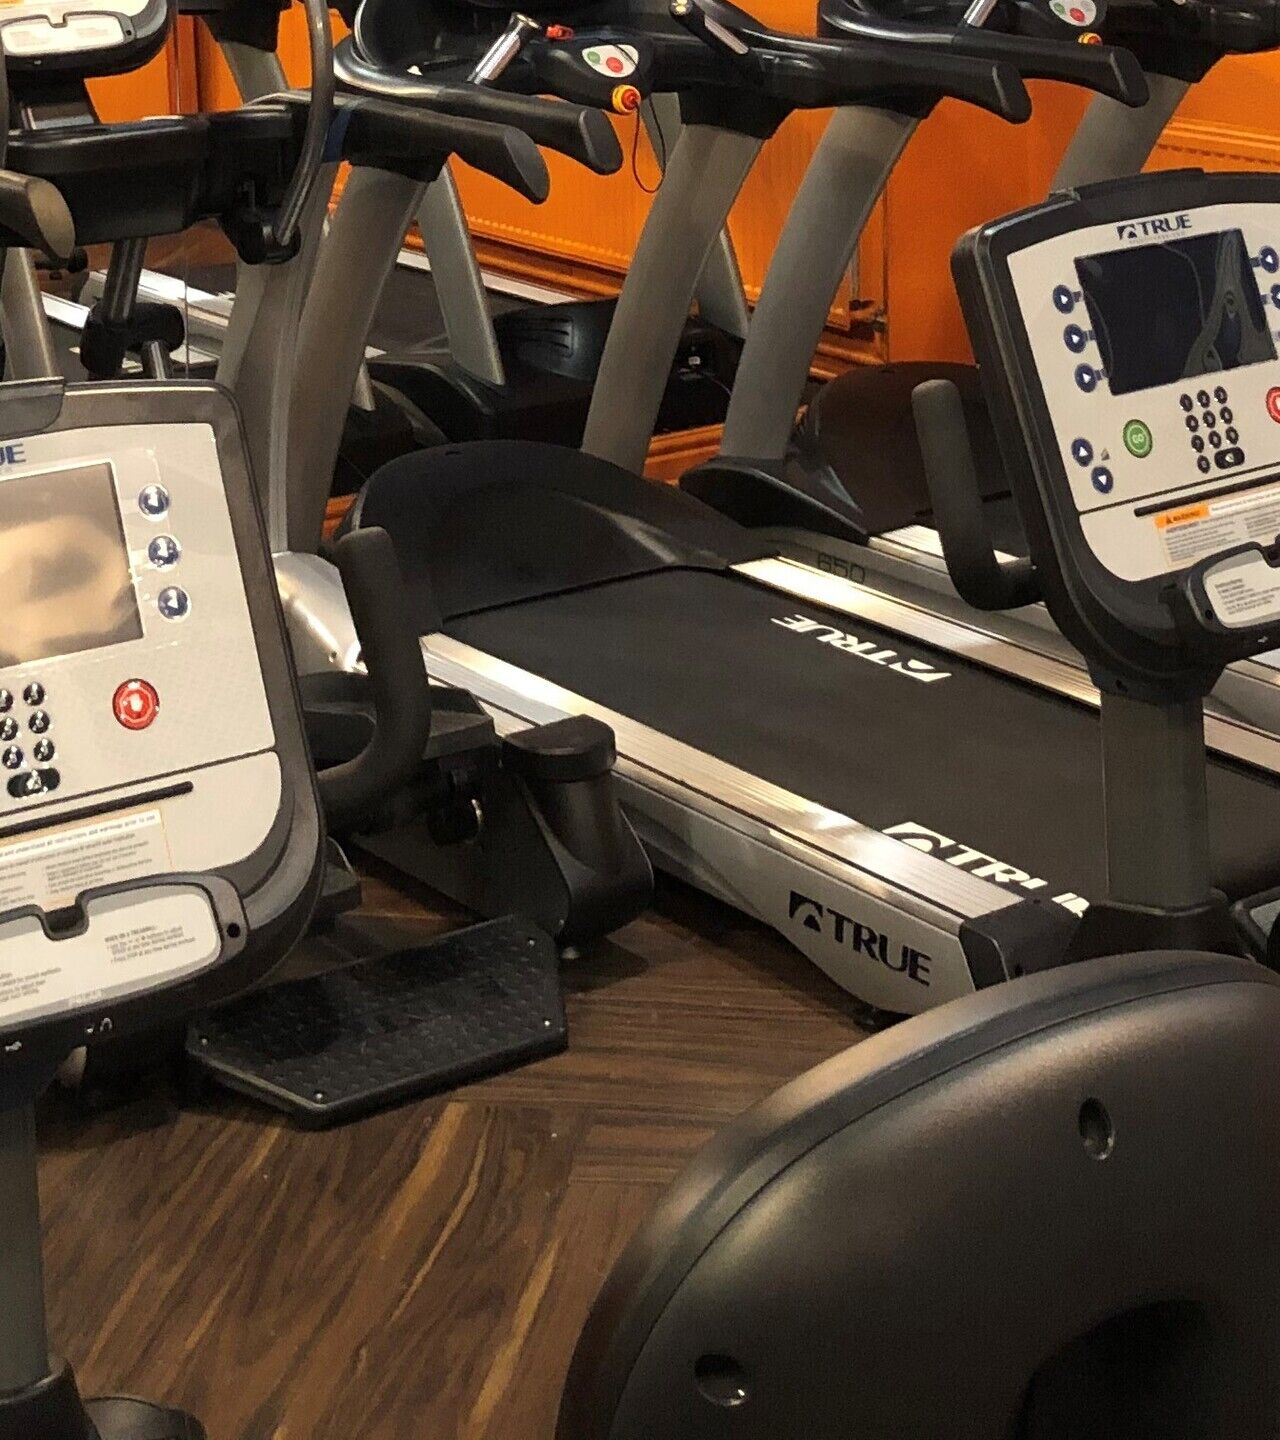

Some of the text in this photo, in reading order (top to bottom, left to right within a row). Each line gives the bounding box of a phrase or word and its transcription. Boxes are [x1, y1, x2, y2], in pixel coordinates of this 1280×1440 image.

[1136, 214, 1192, 236] TRUE
[817, 551, 866, 585] 650
[771, 614, 897, 666] TRUE
[826, 908, 933, 987] TRUE
